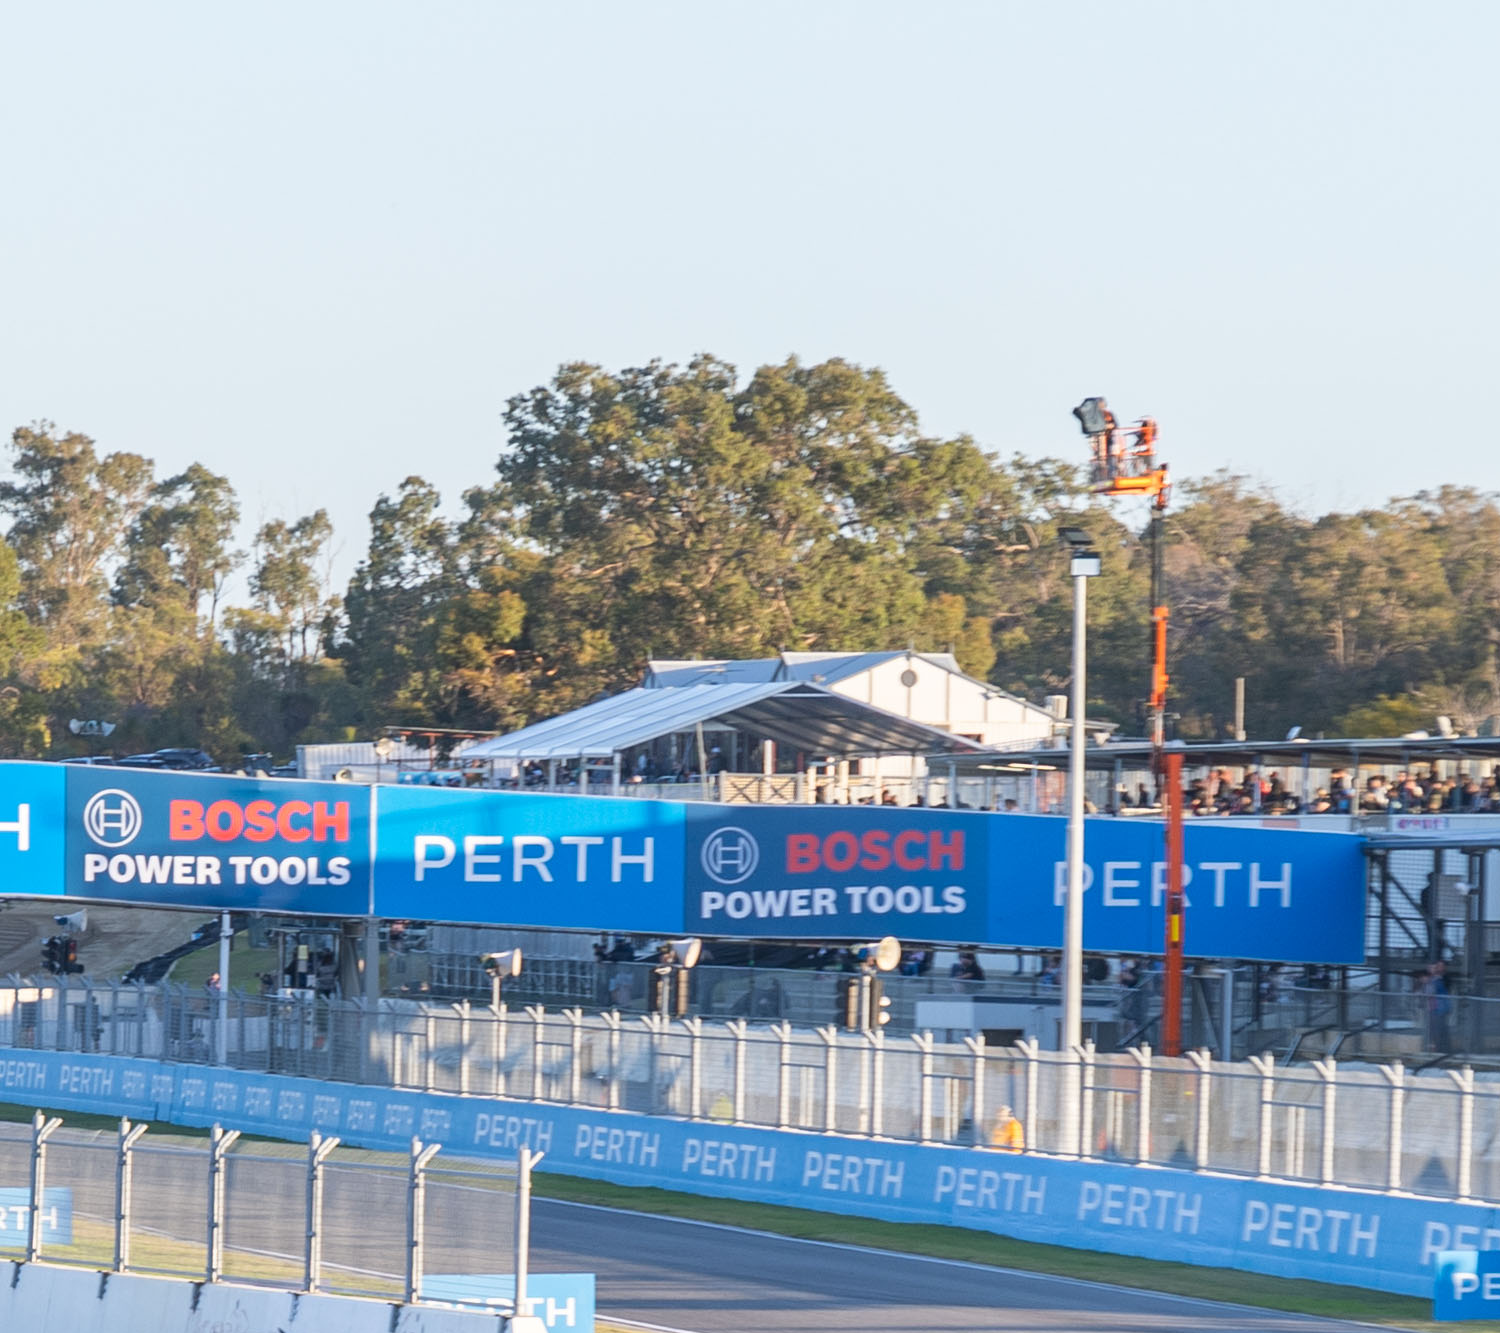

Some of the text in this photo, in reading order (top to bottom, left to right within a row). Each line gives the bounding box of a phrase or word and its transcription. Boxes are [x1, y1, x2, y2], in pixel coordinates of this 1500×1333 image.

[169, 799, 349, 843] BOSCH
[84, 853, 350, 888] POWER TOOLS
[413, 834, 655, 884] PERTH
[784, 829, 965, 875] BOSCH
[700, 885, 966, 921] POWER TOOLS
[1053, 860, 1293, 908] PERTH
[60, 1065, 113, 1096] PERTH
[474, 1113, 554, 1153] PERTH
[574, 1124, 660, 1167] PERTH
[682, 1138, 776, 1182] PERTH
[802, 1151, 904, 1198] PERTH
[935, 1165, 1047, 1214] PERTH
[1077, 1181, 1201, 1235] PERTH
[1242, 1200, 1381, 1258] PERTH
